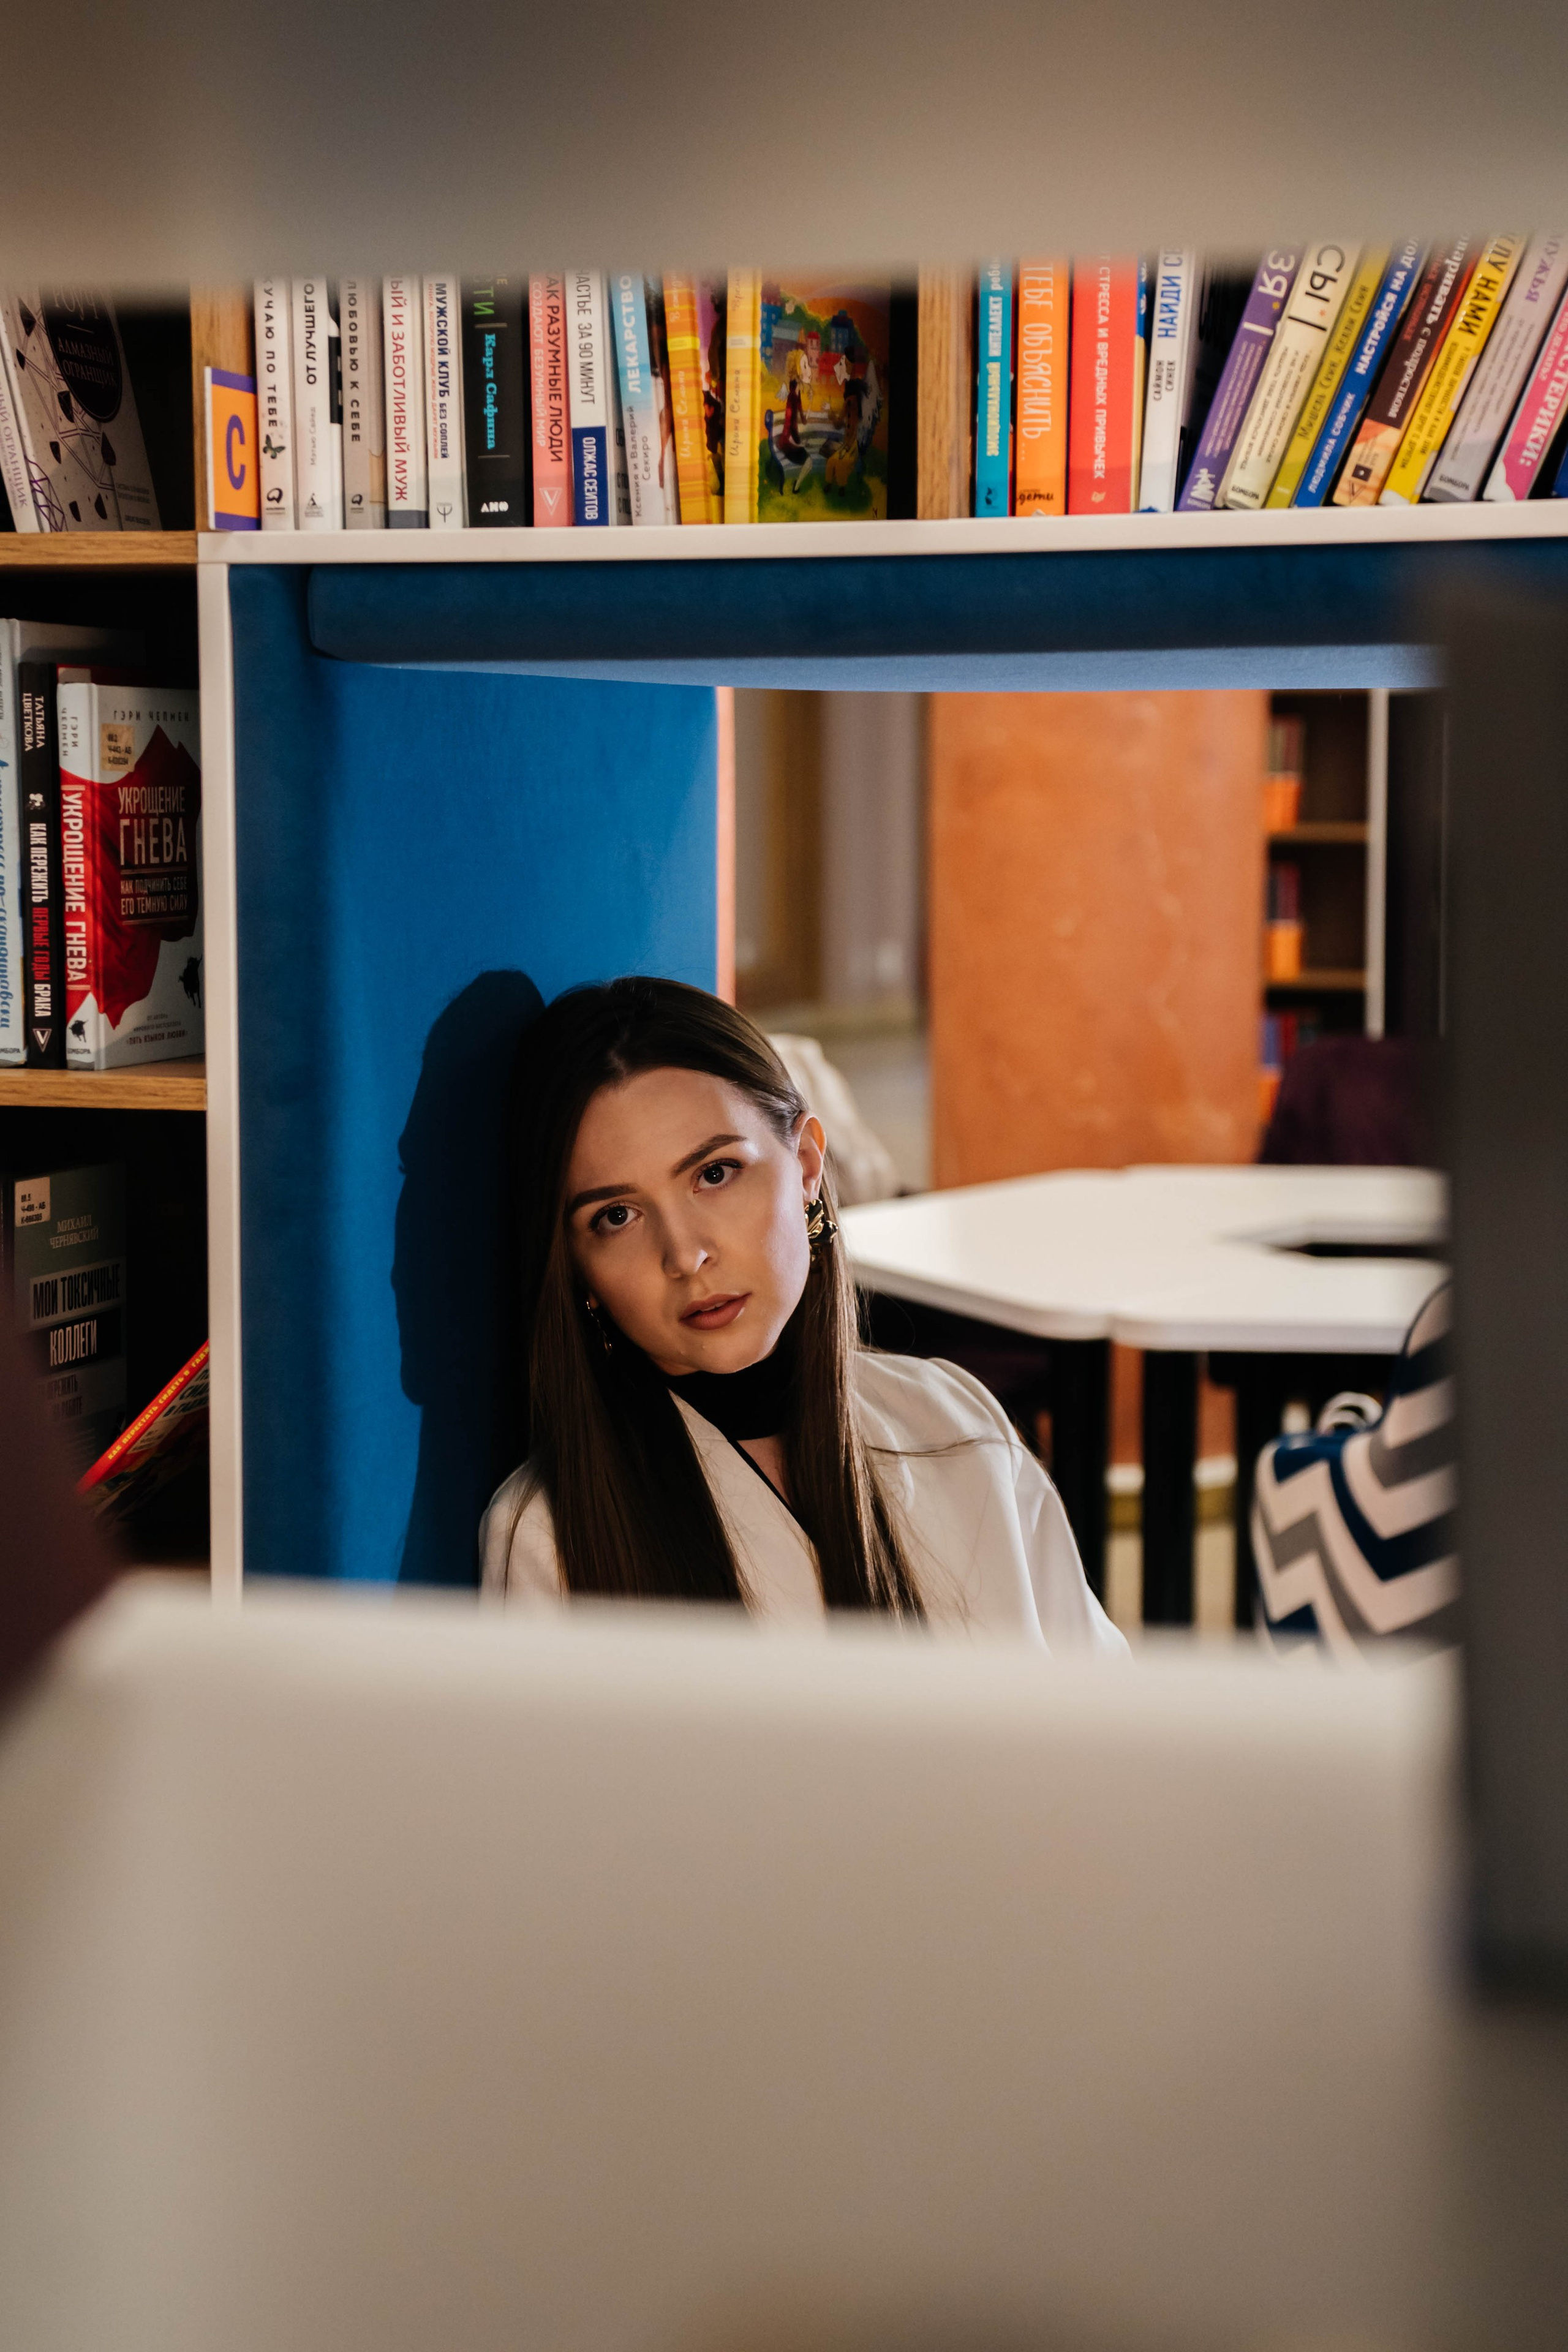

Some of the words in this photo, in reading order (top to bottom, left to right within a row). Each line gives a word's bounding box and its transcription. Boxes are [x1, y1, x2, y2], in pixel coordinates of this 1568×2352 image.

[547, 274, 560, 300] АК
[1024, 266, 1054, 310] ТЕБЕ
[1098, 267, 1111, 324] СТРЕССА
[1158, 276, 1181, 337] НАЙДИ
[1454, 274, 1502, 338] НАМИ
[304, 283, 317, 361] ЛУЧШЕГО
[392, 315, 403, 325] И
[435, 283, 451, 355] МУЖСКОЙ
[532, 282, 544, 343] СОЗДАЮТ
[578, 323, 592, 339] ЗА
[620, 275, 641, 393] ЛЕКАРСТВО
[989, 296, 1003, 356] ИНТЕЛЛЕКТ
[1098, 328, 1109, 337] И
[1354, 291, 1396, 375] НАСТРОЙСЯ
[1390, 269, 1407, 292] НА
[1422, 326, 1433, 336] с
[58, 337, 114, 366] АЛМАЗНЫЙ
[266, 350, 275, 373] ПО
[483, 333, 497, 379] Карл
[547, 306, 562, 401] РАЗУМНЫЕ
[579, 343, 593, 358] 90
[63, 359, 117, 389] ОГРАНЩИК
[306, 364, 317, 385] ОТ
[392, 332, 410, 452] ЗАБОТЛИВЫЙ
[438, 361, 450, 398] КЛУБ
[534, 349, 547, 417] БЕЗУМНЫЙ
[579, 361, 595, 404] МИНУТ
[1095, 342, 1109, 404] ВРЕДНЫХ
[1153, 360, 1164, 401] САЙМОН
[1165, 360, 1175, 392] СИНЕК
[1384, 335, 1428, 418] подростком
[268, 384, 277, 427] ТЕБЕ
[350, 399, 360, 441] СЕБЕ
[484, 382, 499, 450] Сафина
[987, 363, 1001, 456] ЭМОЦИОНАЛЬНЫЙ
[226, 414, 246, 490] С
[440, 423, 448, 459] СОПЛЕЙ
[536, 419, 546, 447] МИР
[549, 405, 563, 462] ЛЮДИ
[627, 406, 639, 459] Валерий
[1094, 409, 1107, 478] ПРИВЫЧЕК
[1307, 436, 1337, 494] ЛЮДМИЛА
[1330, 391, 1355, 437] СОБЧИК
[4, 426, 28, 507] ОГРАНЩИК
[582, 437, 597, 478] ОЛЖАС
[641, 436, 652, 480] Секиро
[394, 460, 407, 500] МУЖ
[633, 474, 643, 517] Ксения
[23, 692, 34, 752] ЦВЕТКОВА
[34, 696, 46, 748] ТАТЬЯНА
[61, 707, 69, 757] ЧЕПМЕН
[70, 717, 80, 748] ГЭРИ
[113, 710, 140, 720] ГЭРИ
[149, 711, 189, 722] ЧЕПМЕН
[118, 786, 186, 816] УКРОЩЕНИЕ
[29, 823, 48, 844] КАК
[60, 793, 87, 912] УКРОЩЕНИЕ
[119, 816, 187, 865] ГНЕВА
[29, 846, 49, 903] ПЕРЕЖИТЬ
[121, 880, 134, 894] КАК
[135, 877, 171, 894] ПОДЧИНИТЬ
[173, 876, 187, 891] СЕБЕ
[121, 897, 134, 915] ЕГО
[137, 895, 167, 914] ТЕМНУЮ
[169, 893, 187, 911] СИЛУ
[32, 907, 49, 948] ПЕРВЫЕ
[31, 950, 50, 980] ГОДЫ
[65, 921, 88, 980] ГНЕВА
[34, 983, 51, 1017] БРАКА
[144, 1033, 165, 1043] ЯЗЫКОВ
[49, 1227, 99, 1249] ЧЕРНЯВСКИЙ
[58, 1215, 92, 1232] МИХАИЛ
[33, 1279, 58, 1320] МОИ
[61, 1264, 121, 1312] ТОКСИЧНЫЕ
[50, 1319, 98, 1368] КОЛЛЕГИ
[107, 1444, 122, 1460] КАК
[121, 1404, 159, 1444] ПЕРЕСТАТЬ
[157, 1375, 184, 1404] СИДЕТЬ
